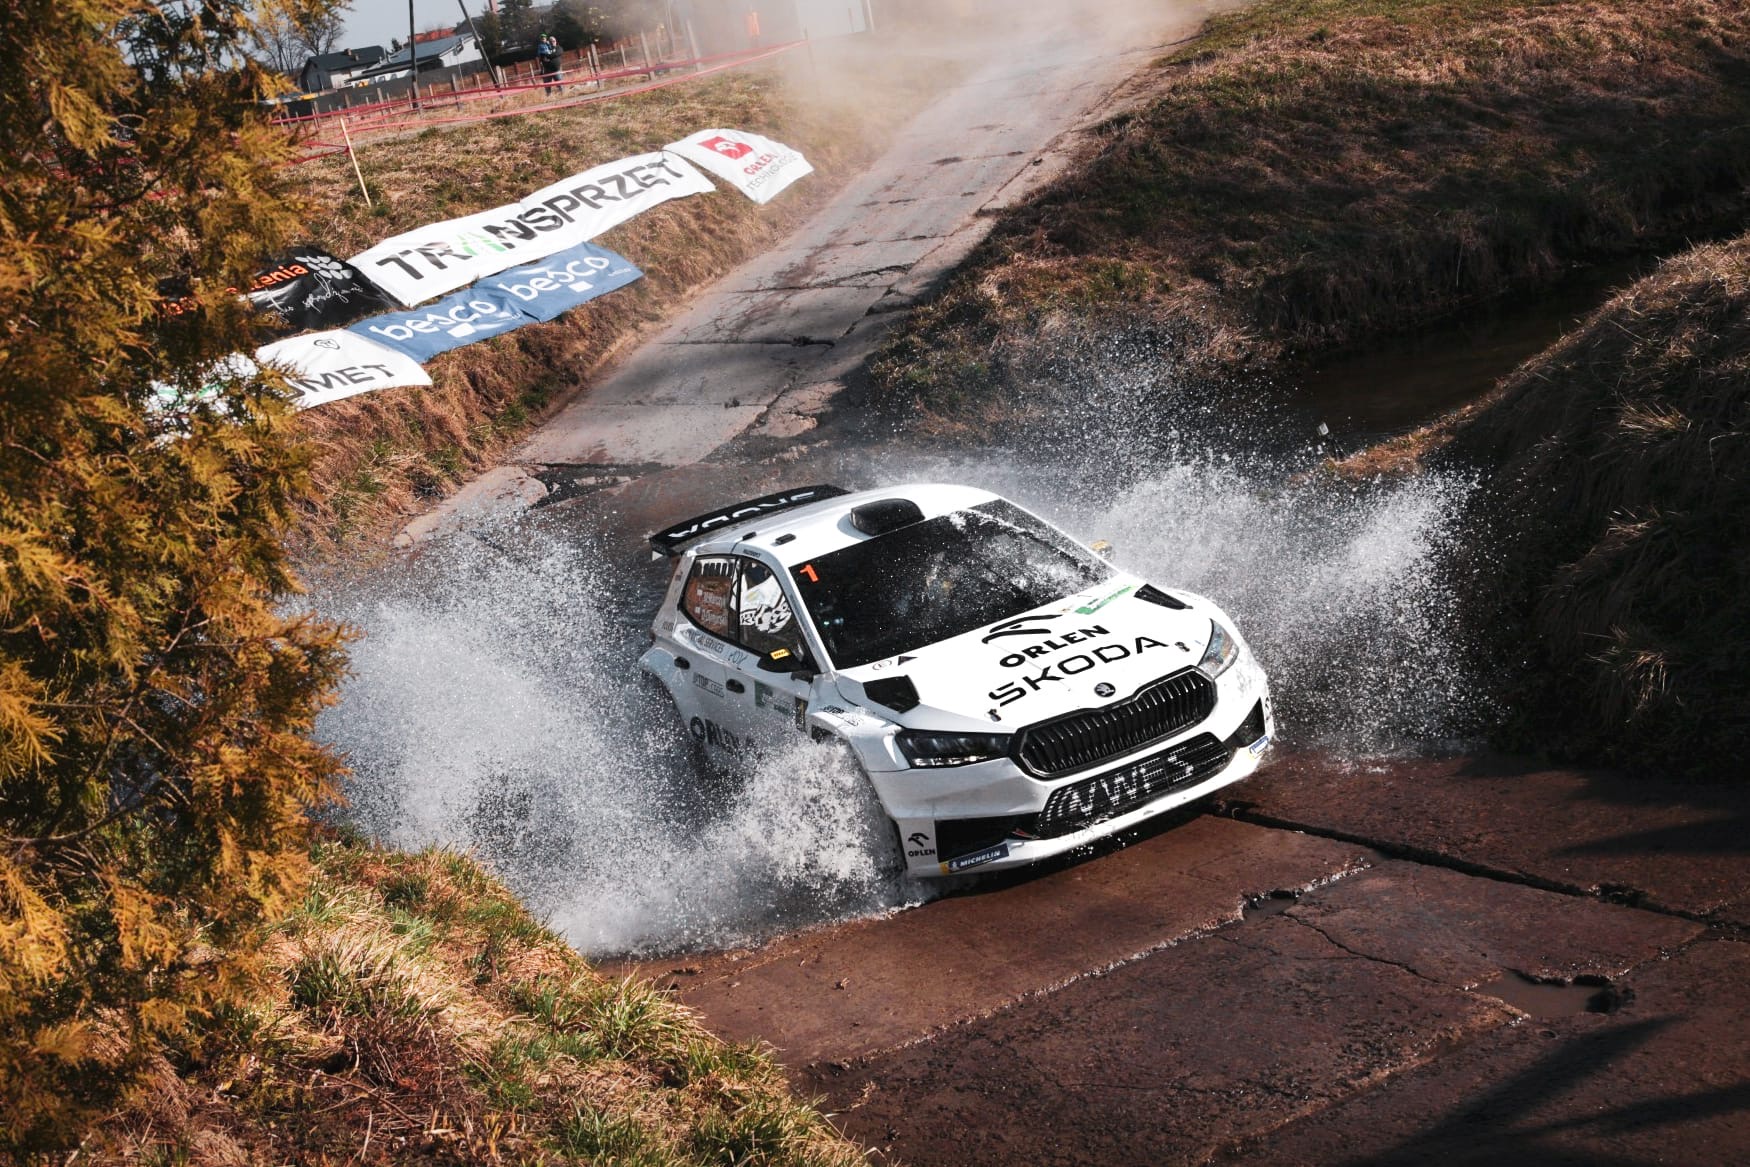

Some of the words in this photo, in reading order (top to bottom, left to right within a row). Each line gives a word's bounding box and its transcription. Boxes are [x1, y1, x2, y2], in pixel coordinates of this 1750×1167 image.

[375, 158, 683, 280] TRANSPRZET
[499, 256, 610, 301] besco
[369, 300, 498, 341] besco
[800, 564, 819, 582] 1
[999, 625, 1111, 667] ORLEN
[988, 636, 1169, 707] SKODA
[908, 846, 937, 857] ORLEN
[960, 850, 1002, 868] MICHELIN
